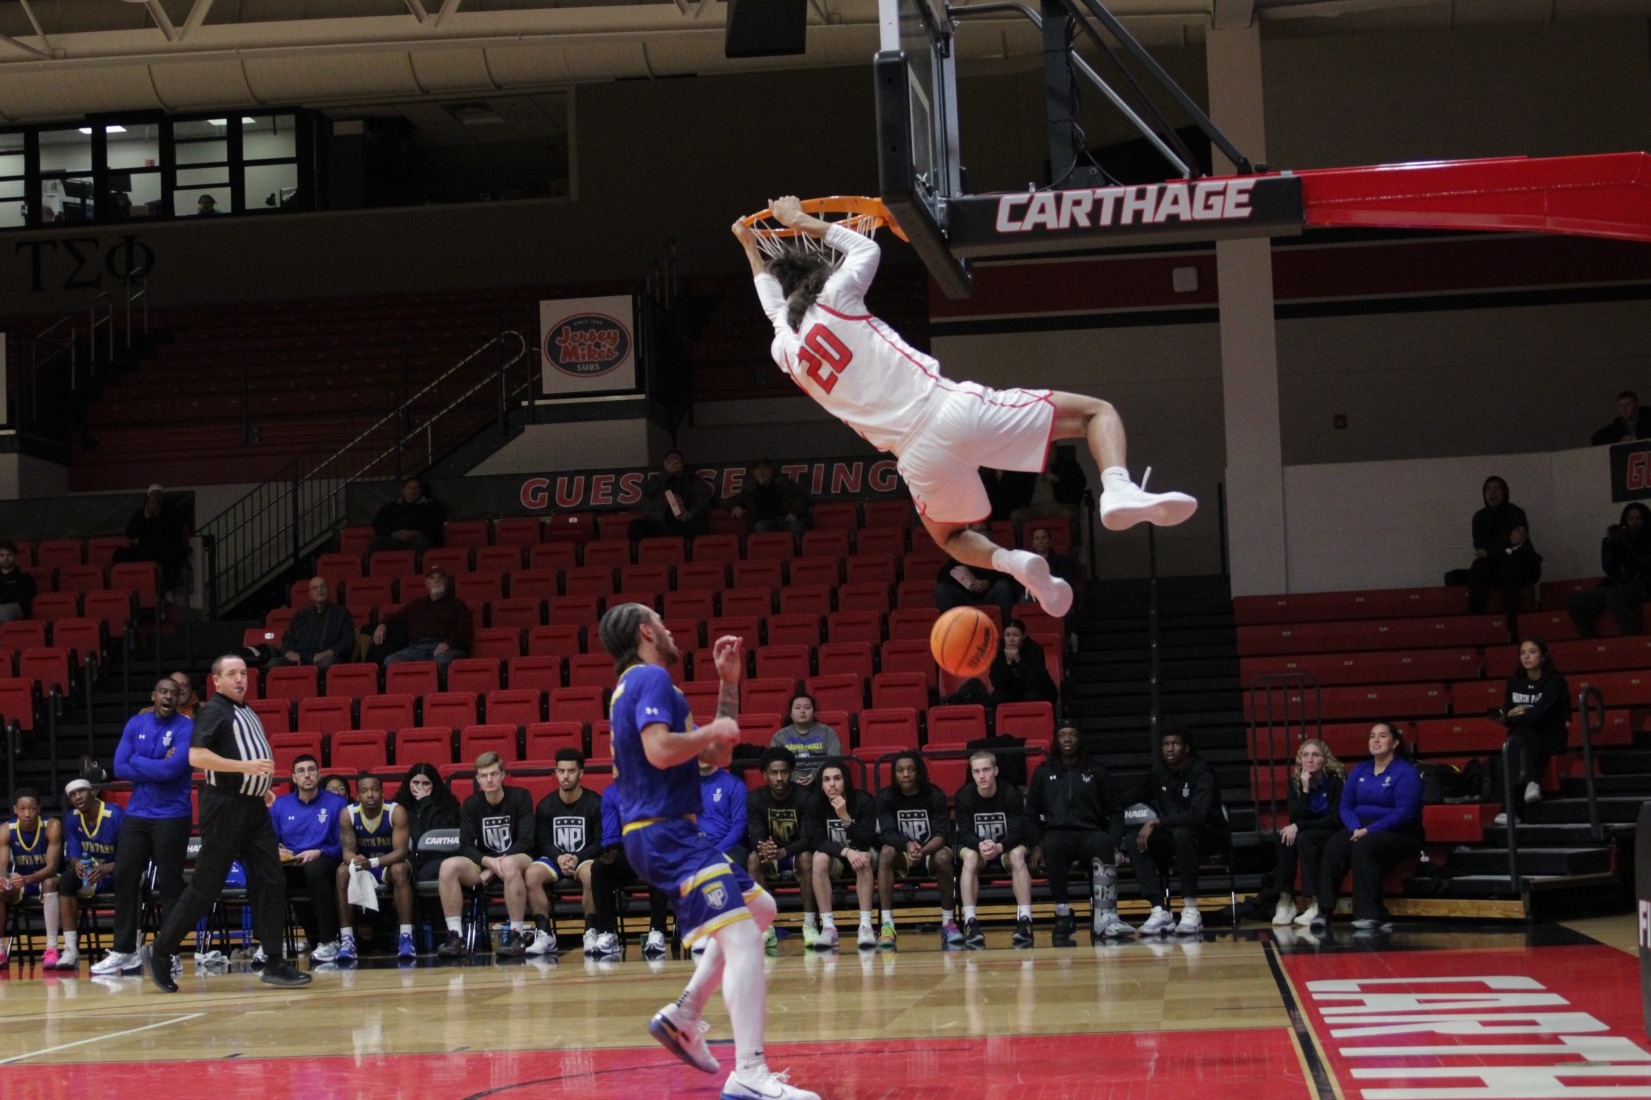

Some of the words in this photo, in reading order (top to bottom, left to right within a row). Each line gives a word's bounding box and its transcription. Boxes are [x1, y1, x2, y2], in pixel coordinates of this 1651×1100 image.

[995, 179, 1257, 233] CARTHAGE
[556, 326, 619, 346] Jersey
[576, 363, 600, 371] SUBS
[796, 322, 853, 395] 20
[519, 472, 653, 510] GUES
[695, 460, 899, 501] SETING
[425, 837, 460, 845] CARTHA
[486, 826, 510, 851] NP
[556, 827, 582, 852] NP
